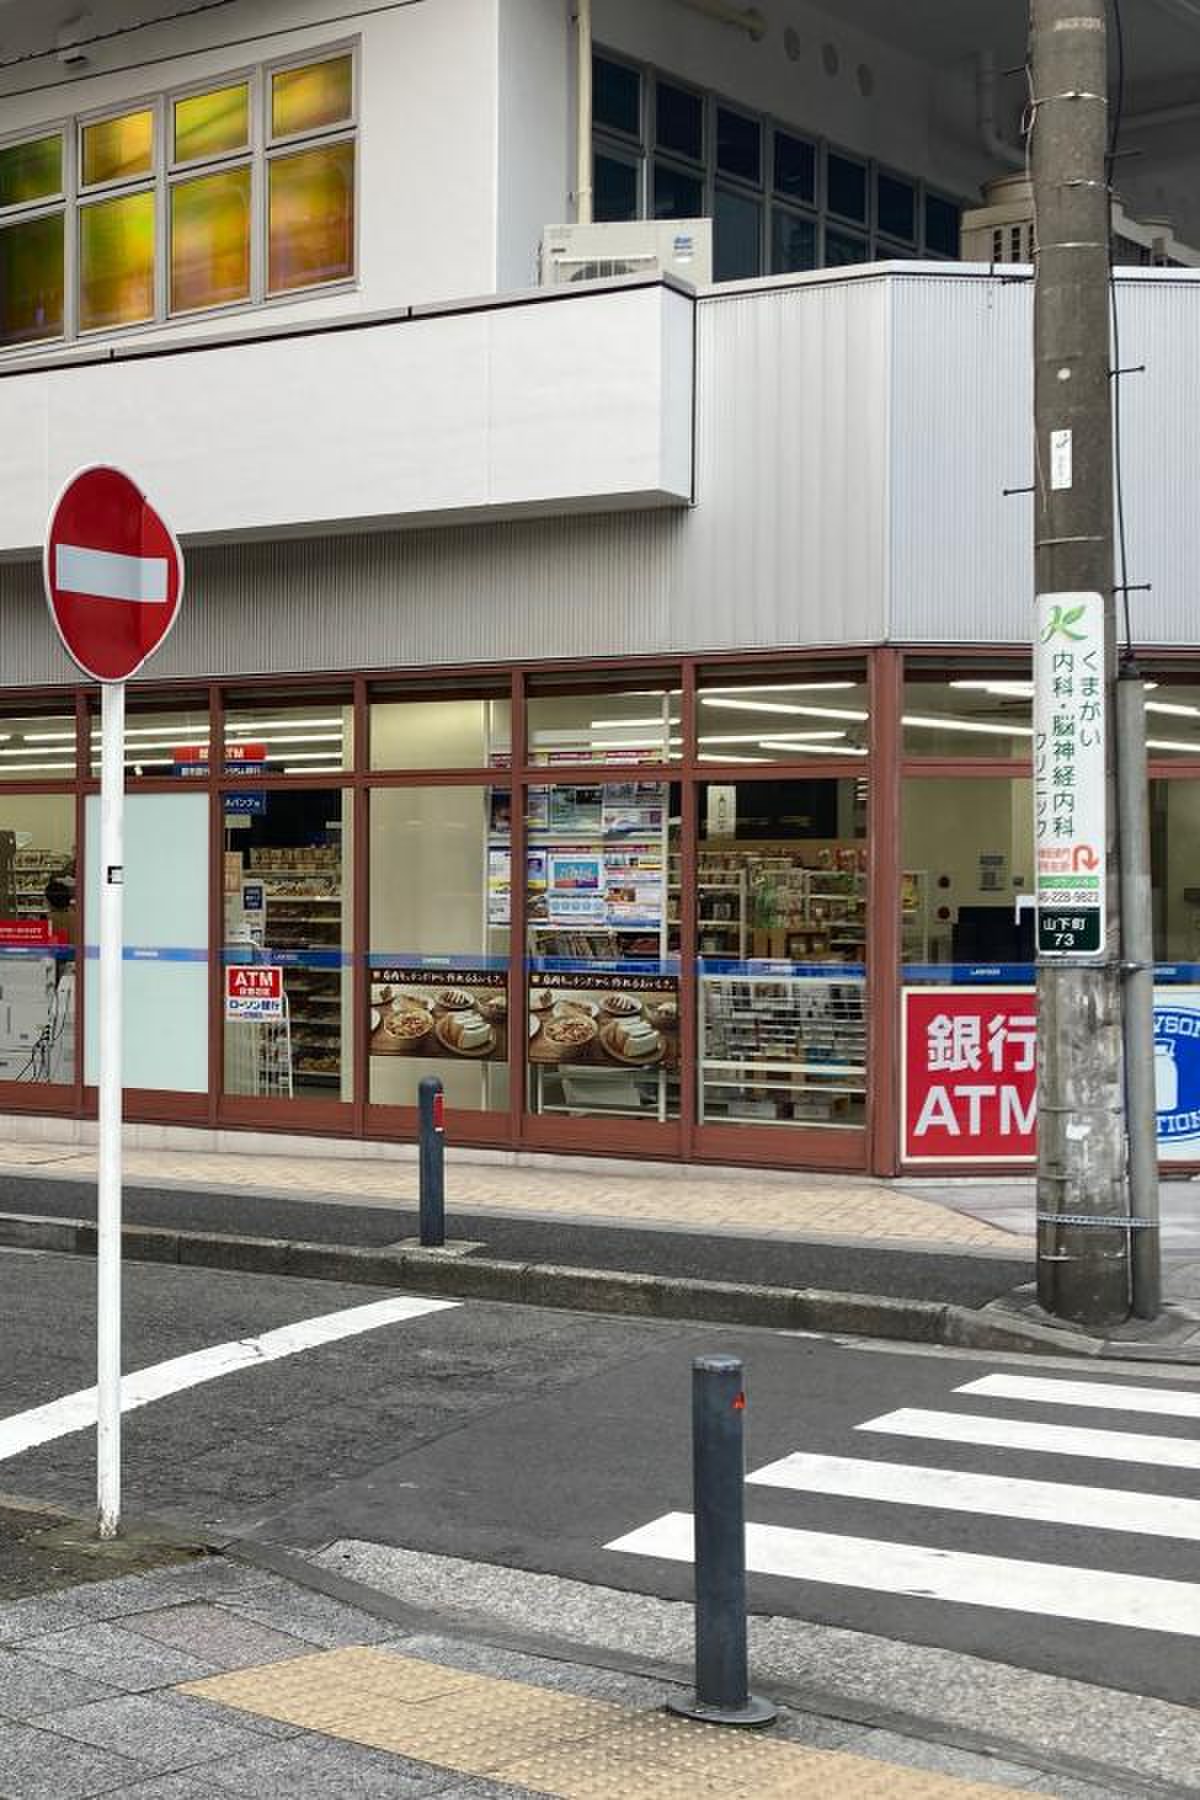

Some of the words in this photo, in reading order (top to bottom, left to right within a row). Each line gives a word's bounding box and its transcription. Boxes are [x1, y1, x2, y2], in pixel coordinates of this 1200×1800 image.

[1080, 650, 1101, 747] くまがい
[1053, 651, 1075, 839] 内科・脳神経内科
[1043, 917, 1087, 930] 山下町
[1055, 933, 1075, 947] 73
[234, 970, 273, 987] ATM
[927, 1013, 1037, 1072] 銀行
[913, 1085, 1037, 1136] ATM
